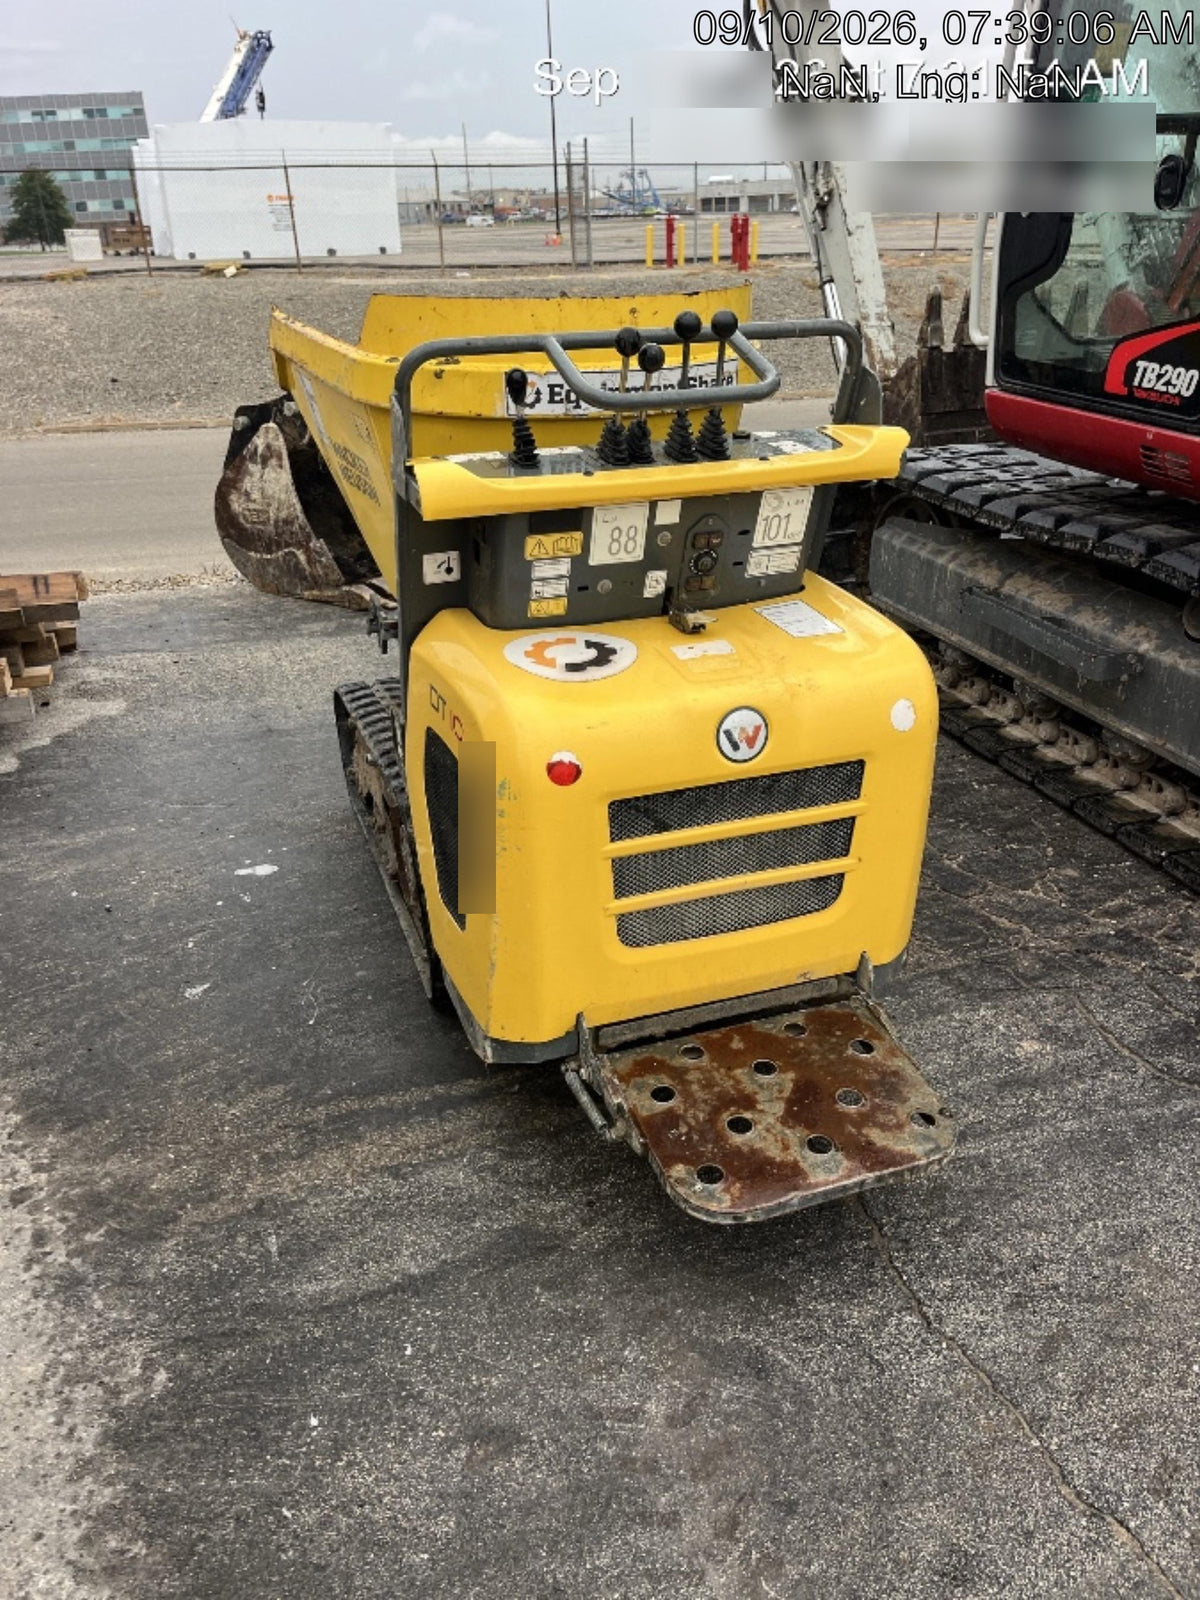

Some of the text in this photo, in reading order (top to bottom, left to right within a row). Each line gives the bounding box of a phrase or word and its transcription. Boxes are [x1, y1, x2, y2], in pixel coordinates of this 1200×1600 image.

[1132, 360, 1199, 397] TB290
[608, 525, 637, 555] 88
[762, 513, 791, 541] 101
